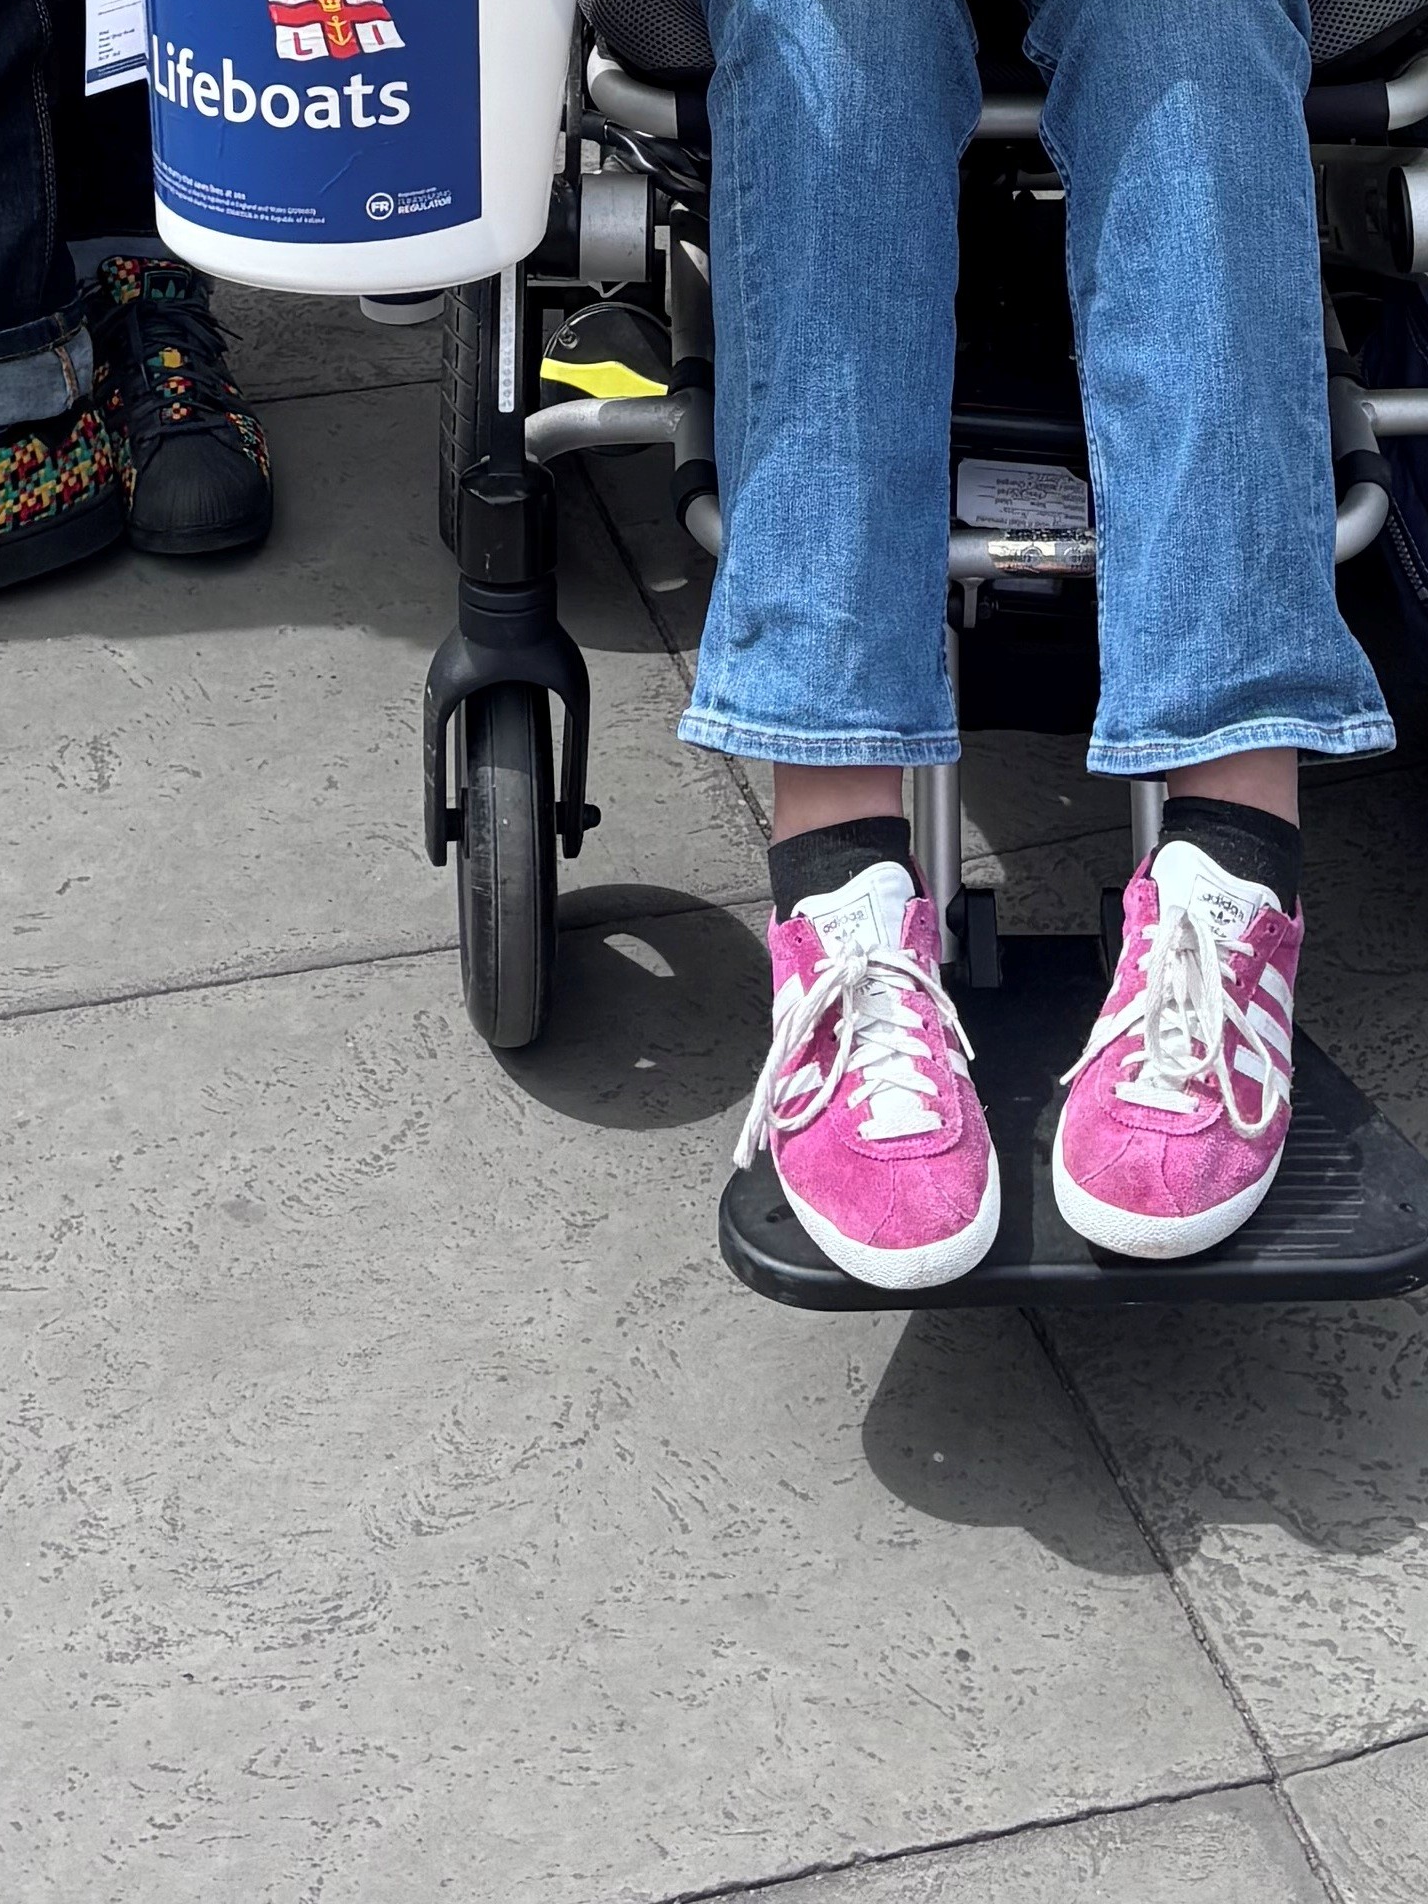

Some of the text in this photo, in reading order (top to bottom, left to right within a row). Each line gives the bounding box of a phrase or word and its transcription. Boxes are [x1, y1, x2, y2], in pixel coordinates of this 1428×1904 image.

[150, 35, 412, 130] Lifeboats
[371, 200, 390, 213] FR
[398, 195, 452, 214] REGULATOR
